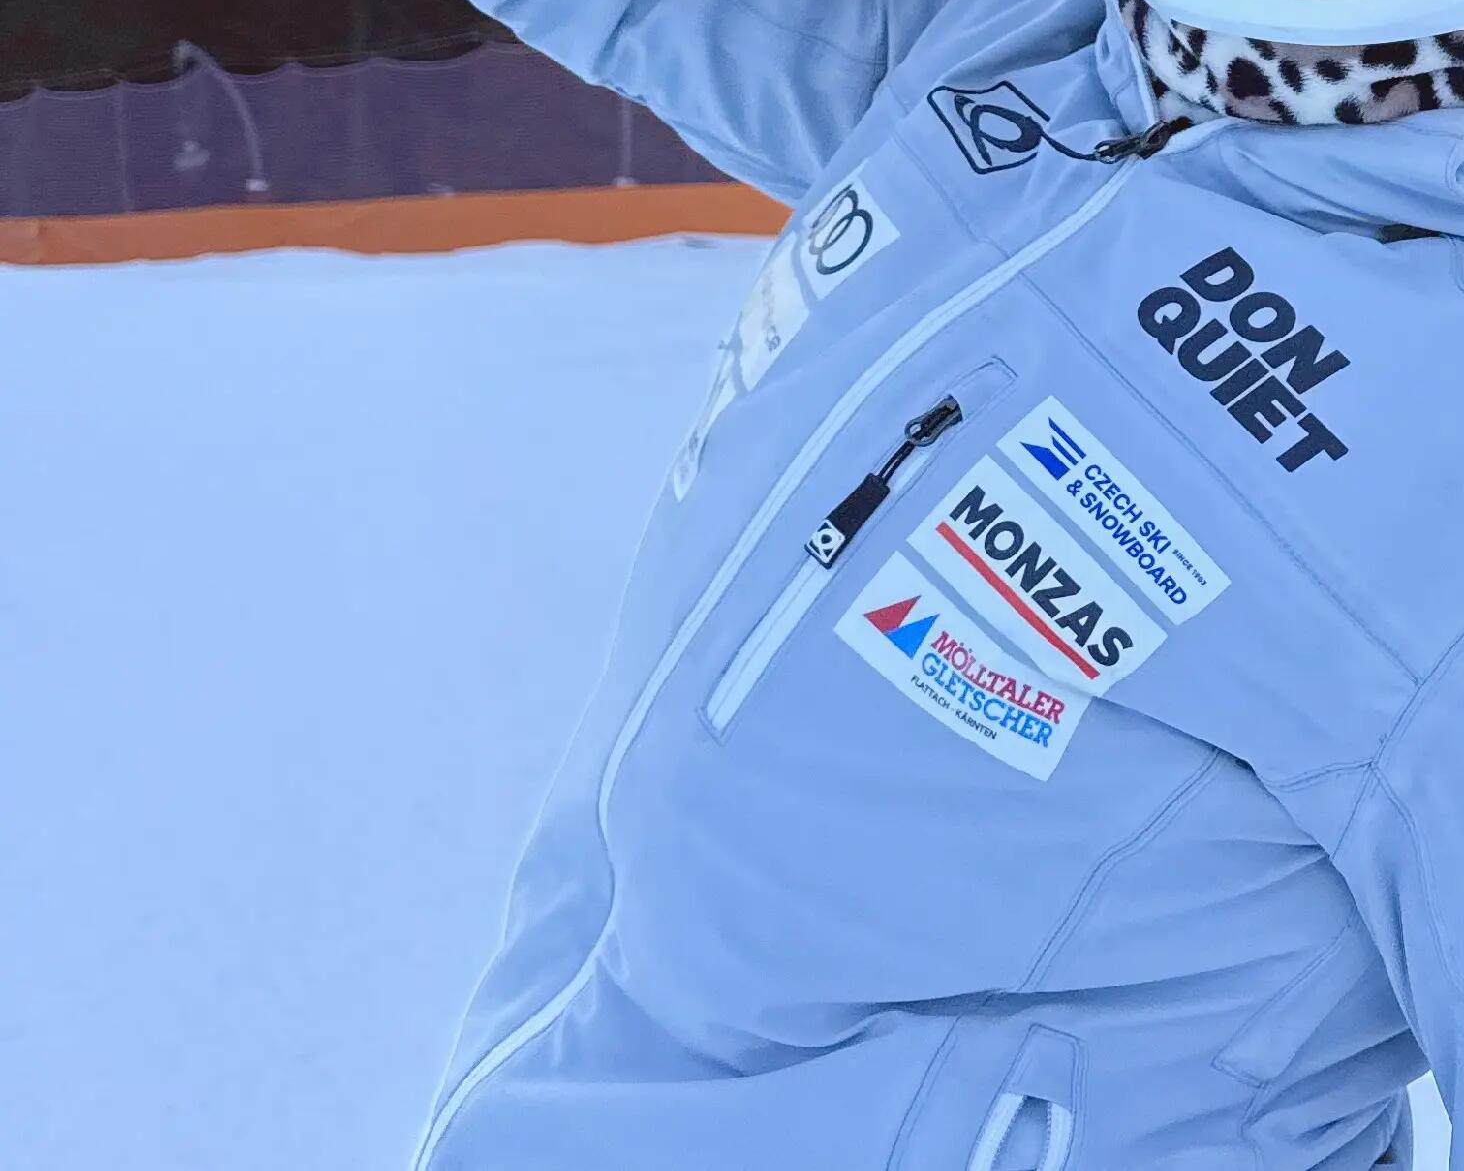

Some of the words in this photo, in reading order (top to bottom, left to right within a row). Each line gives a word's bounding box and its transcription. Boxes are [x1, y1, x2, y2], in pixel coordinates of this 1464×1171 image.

[1179, 246, 1351, 395] DON
[1138, 286, 1349, 473] QUIET
[1066, 479, 1083, 497] &
[1079, 491, 1187, 605] SNOWBOARD
[1084, 463, 1143, 524] CZECH
[1139, 520, 1172, 555] SKI
[949, 484, 1134, 667] MONZAS
[910, 675, 951, 710] FLATTACH
[955, 709, 997, 741] KÄRNTEN
[921, 652, 1053, 748] GLETSCHER
[930, 630, 1065, 725] MÖLLTALER
